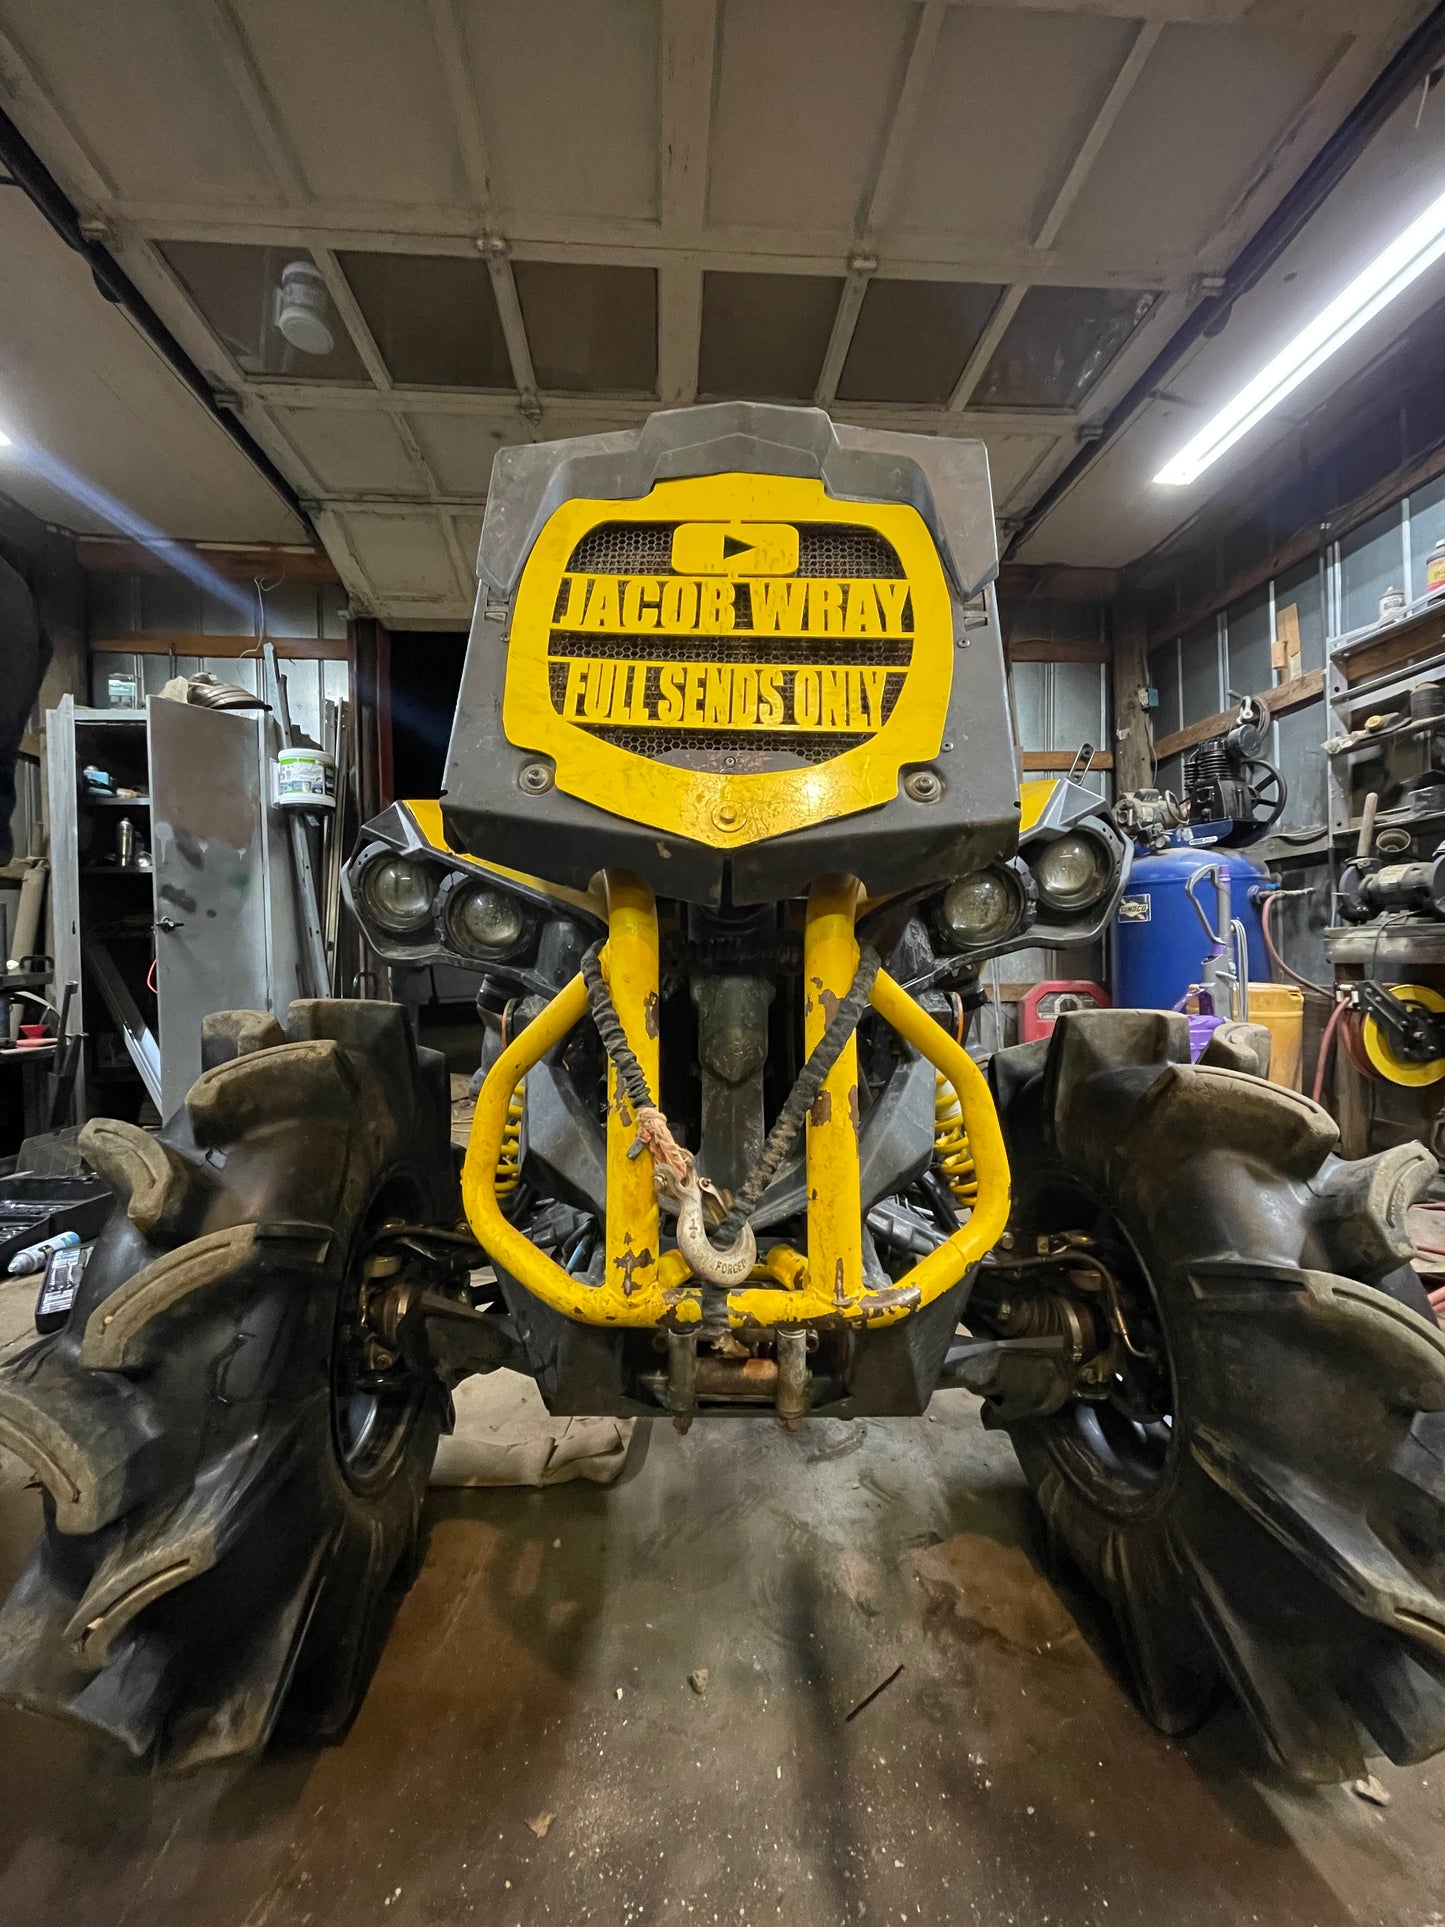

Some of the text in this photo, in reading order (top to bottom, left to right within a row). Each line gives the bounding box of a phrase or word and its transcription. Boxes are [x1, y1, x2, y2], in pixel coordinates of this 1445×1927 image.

[560, 577, 909, 634] JACOB WRAY
[563, 661, 887, 728] FULL SENDS ONLY
[714, 1258, 747, 1275] FORGED
